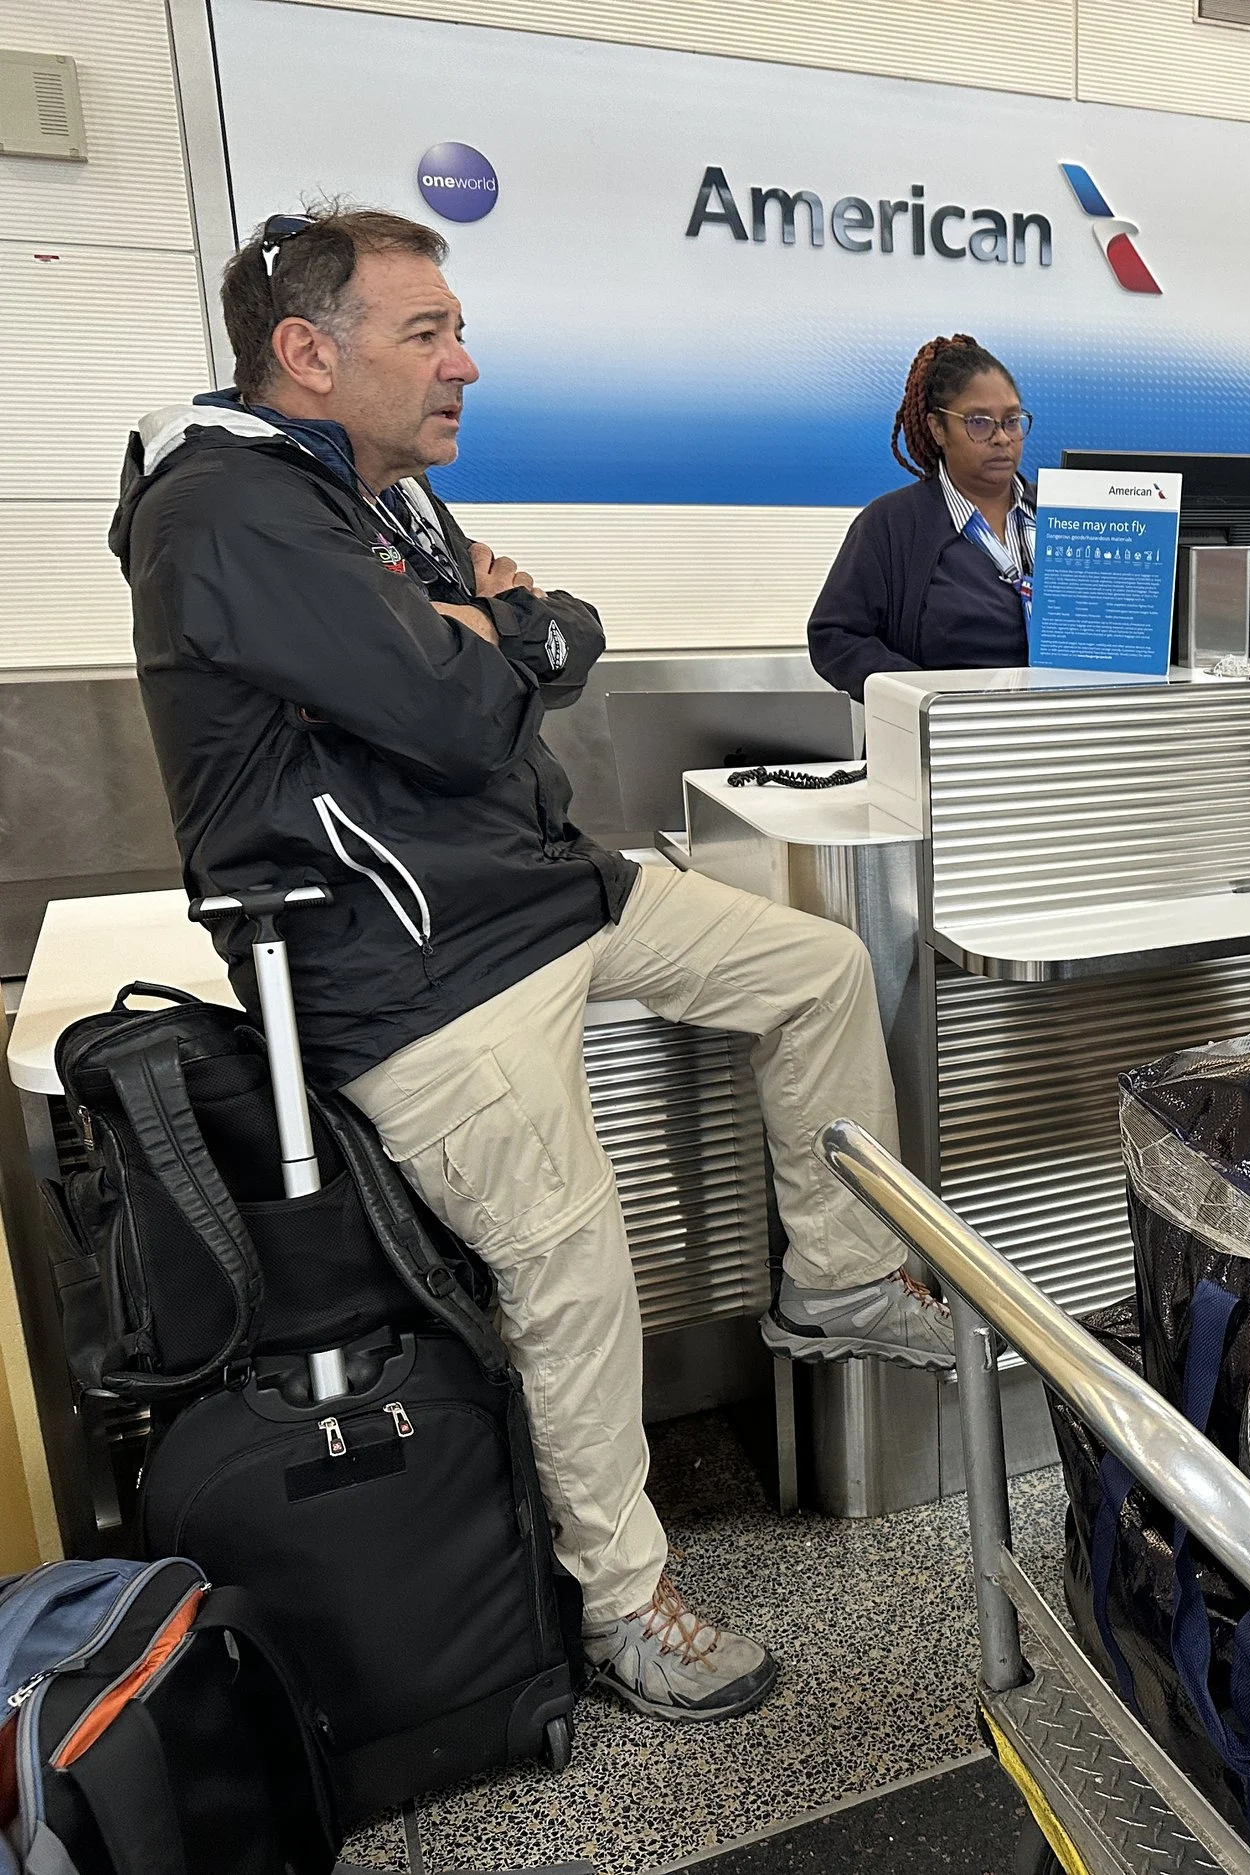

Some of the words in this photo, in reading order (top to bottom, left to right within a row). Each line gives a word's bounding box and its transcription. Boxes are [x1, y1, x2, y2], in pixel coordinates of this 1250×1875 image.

[422, 175, 496, 191] oneworld
[685, 165, 1053, 267] American
[1108, 485, 1152, 497] American
[1048, 517, 1080, 530] These
[1082, 521, 1107, 535] may
[1109, 521, 1129, 532] not
[1132, 520, 1147, 536] fly.
